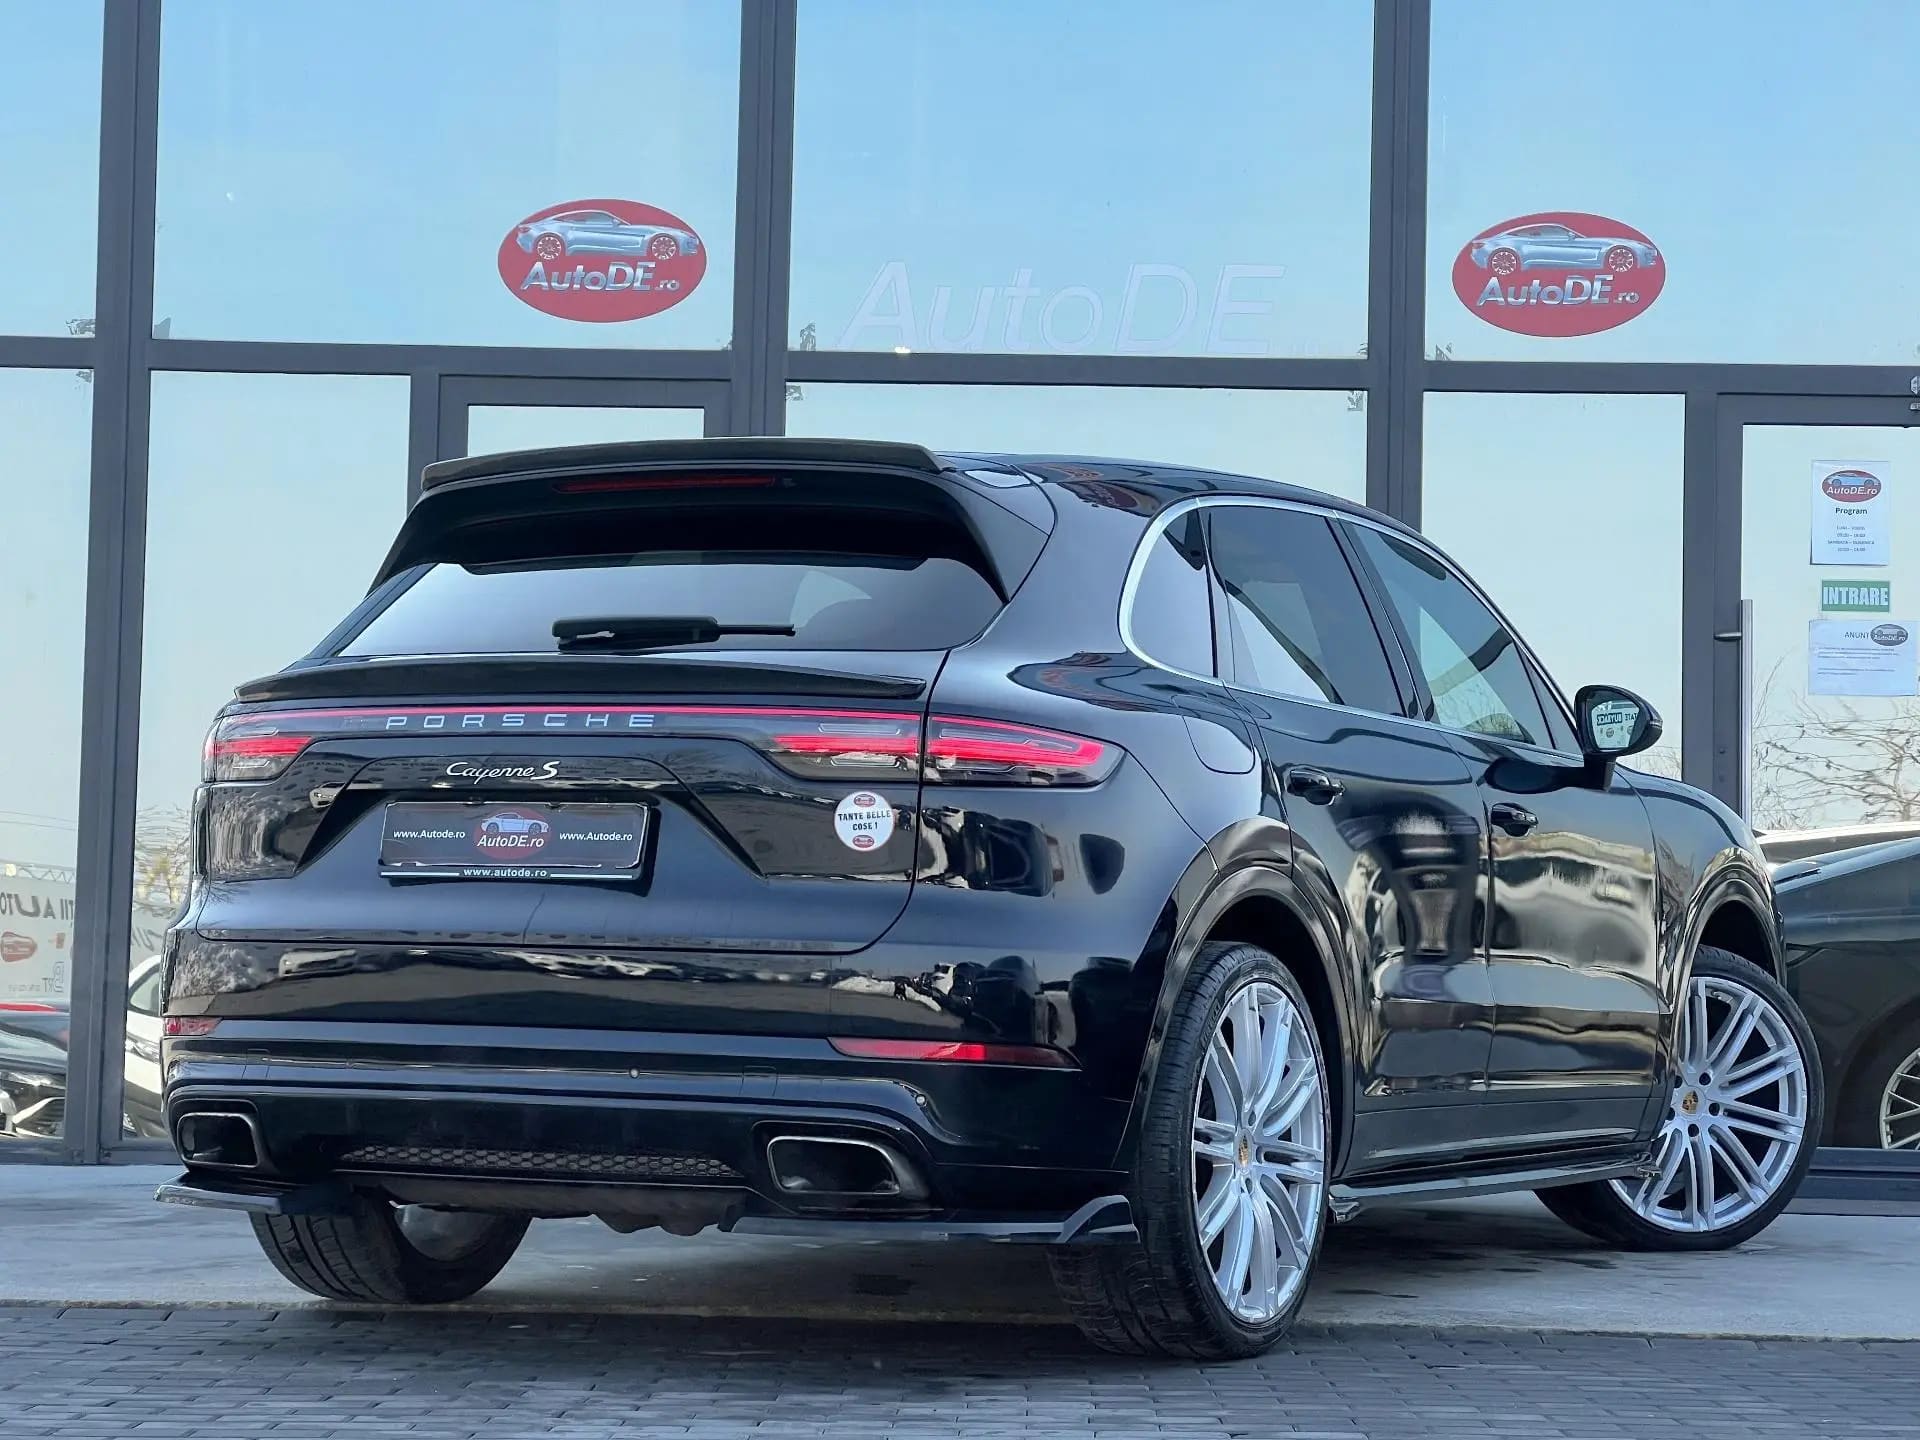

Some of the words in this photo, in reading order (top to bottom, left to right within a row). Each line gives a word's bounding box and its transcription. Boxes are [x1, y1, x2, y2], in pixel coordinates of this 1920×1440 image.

[831, 259, 1287, 354] AutoDE
[1826, 485, 1878, 496] AutoDE.ro
[1835, 506, 1868, 516] Program
[1823, 586, 1889, 606] INTRARE
[386, 713, 655, 729] PORSCHE
[446, 761, 535, 785] Cayenne
[531, 760, 561, 781] S
[838, 812, 864, 822] TANTE
[866, 810, 891, 819] BELLE
[852, 822, 873, 831] COSE
[393, 829, 466, 840] www.Autode.ro
[559, 831, 633, 842] www.Autode.ro
[476, 834, 545, 849] AutoDE.ro
[463, 868, 548, 878] www.autode.ro
